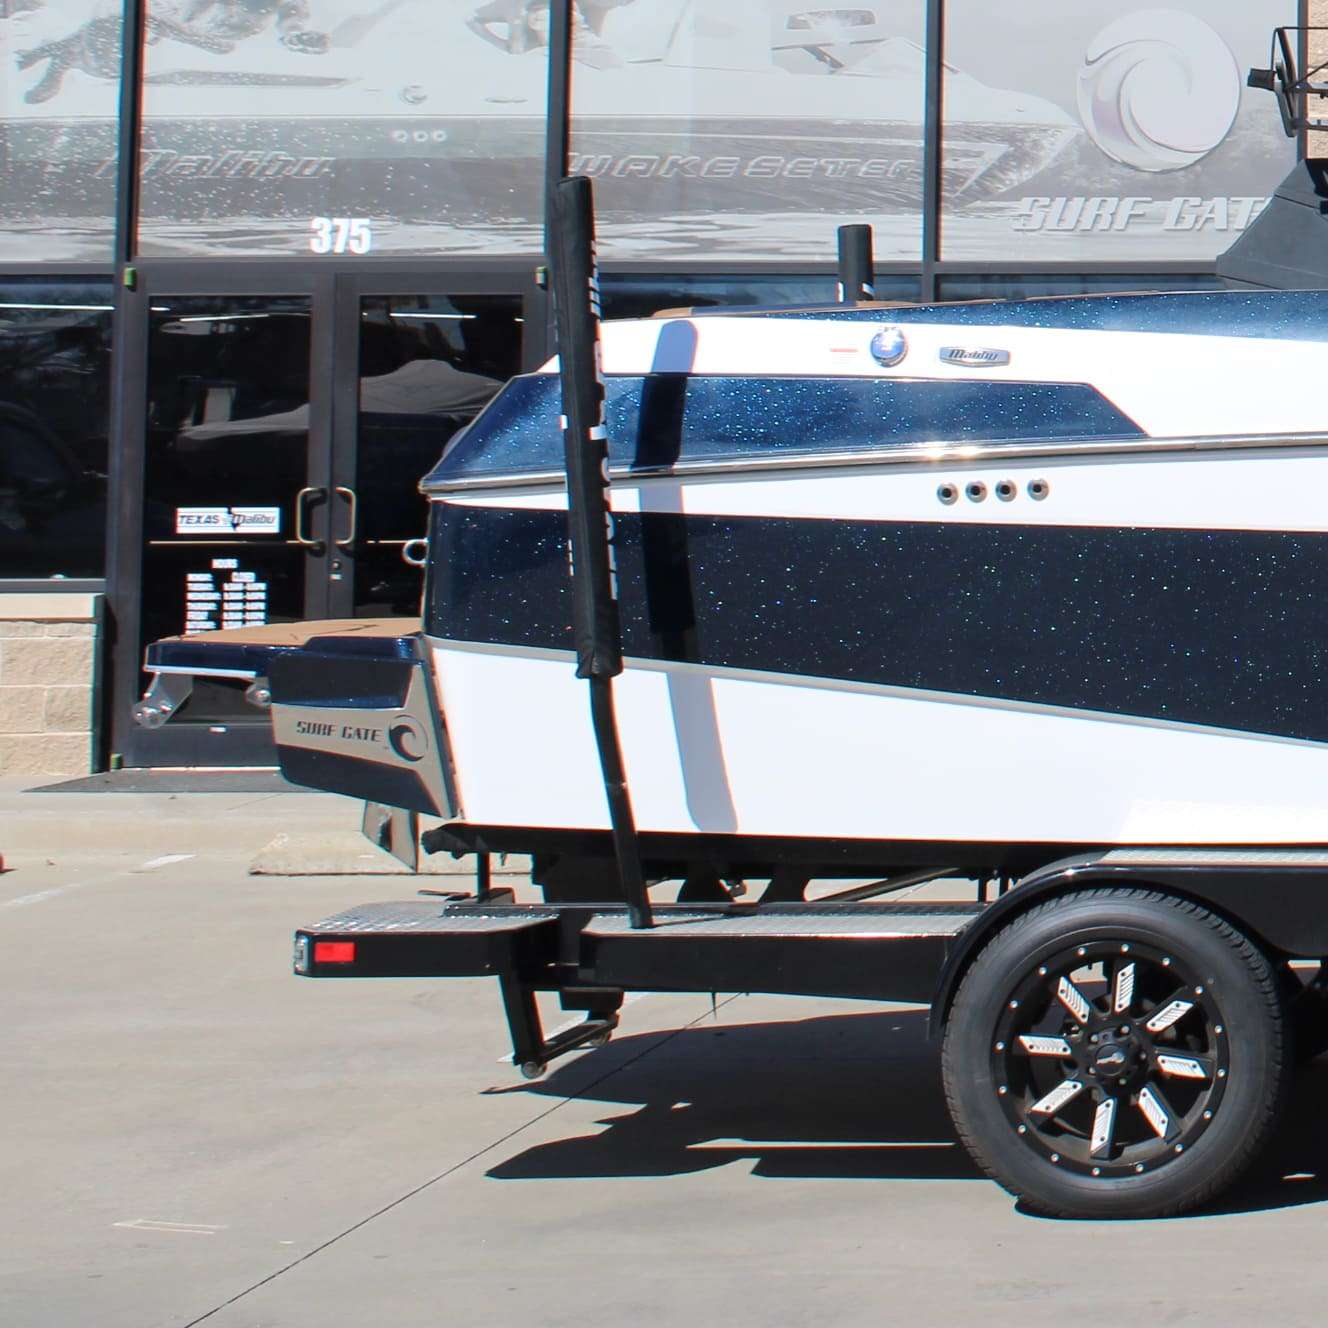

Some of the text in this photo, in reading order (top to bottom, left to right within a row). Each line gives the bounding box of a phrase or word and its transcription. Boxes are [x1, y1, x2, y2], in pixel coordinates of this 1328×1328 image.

[1012, 196, 1274, 232] SURF GAT
[311, 218, 371, 253] 375
[180, 515, 219, 524] TEXAS
[297, 721, 382, 742] SURF GATE
